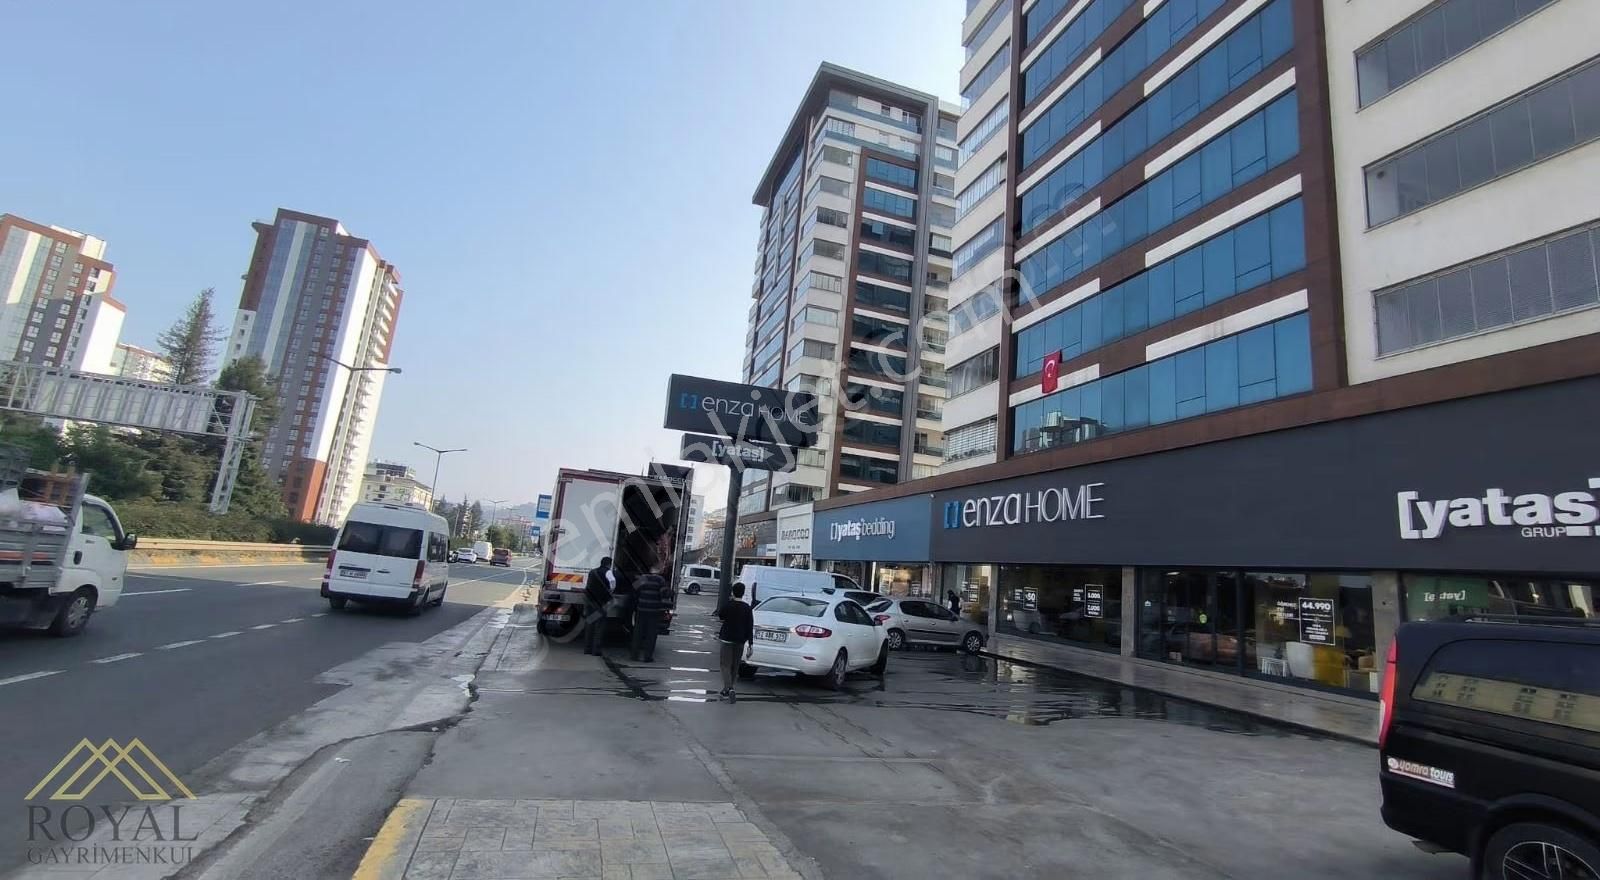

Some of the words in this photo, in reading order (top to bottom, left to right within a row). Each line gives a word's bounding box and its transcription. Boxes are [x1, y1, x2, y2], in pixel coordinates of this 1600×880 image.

[702, 396, 754, 418] enza
[758, 405, 809, 424] HOME
[963, 493, 1021, 527] enza
[1025, 482, 1104, 522] HOME
[861, 516, 896, 540] bedding
[1521, 527, 1568, 538] GRUP
[1302, 602, 1331, 610] 44.990
[1430, 766, 1455, 782] tours
